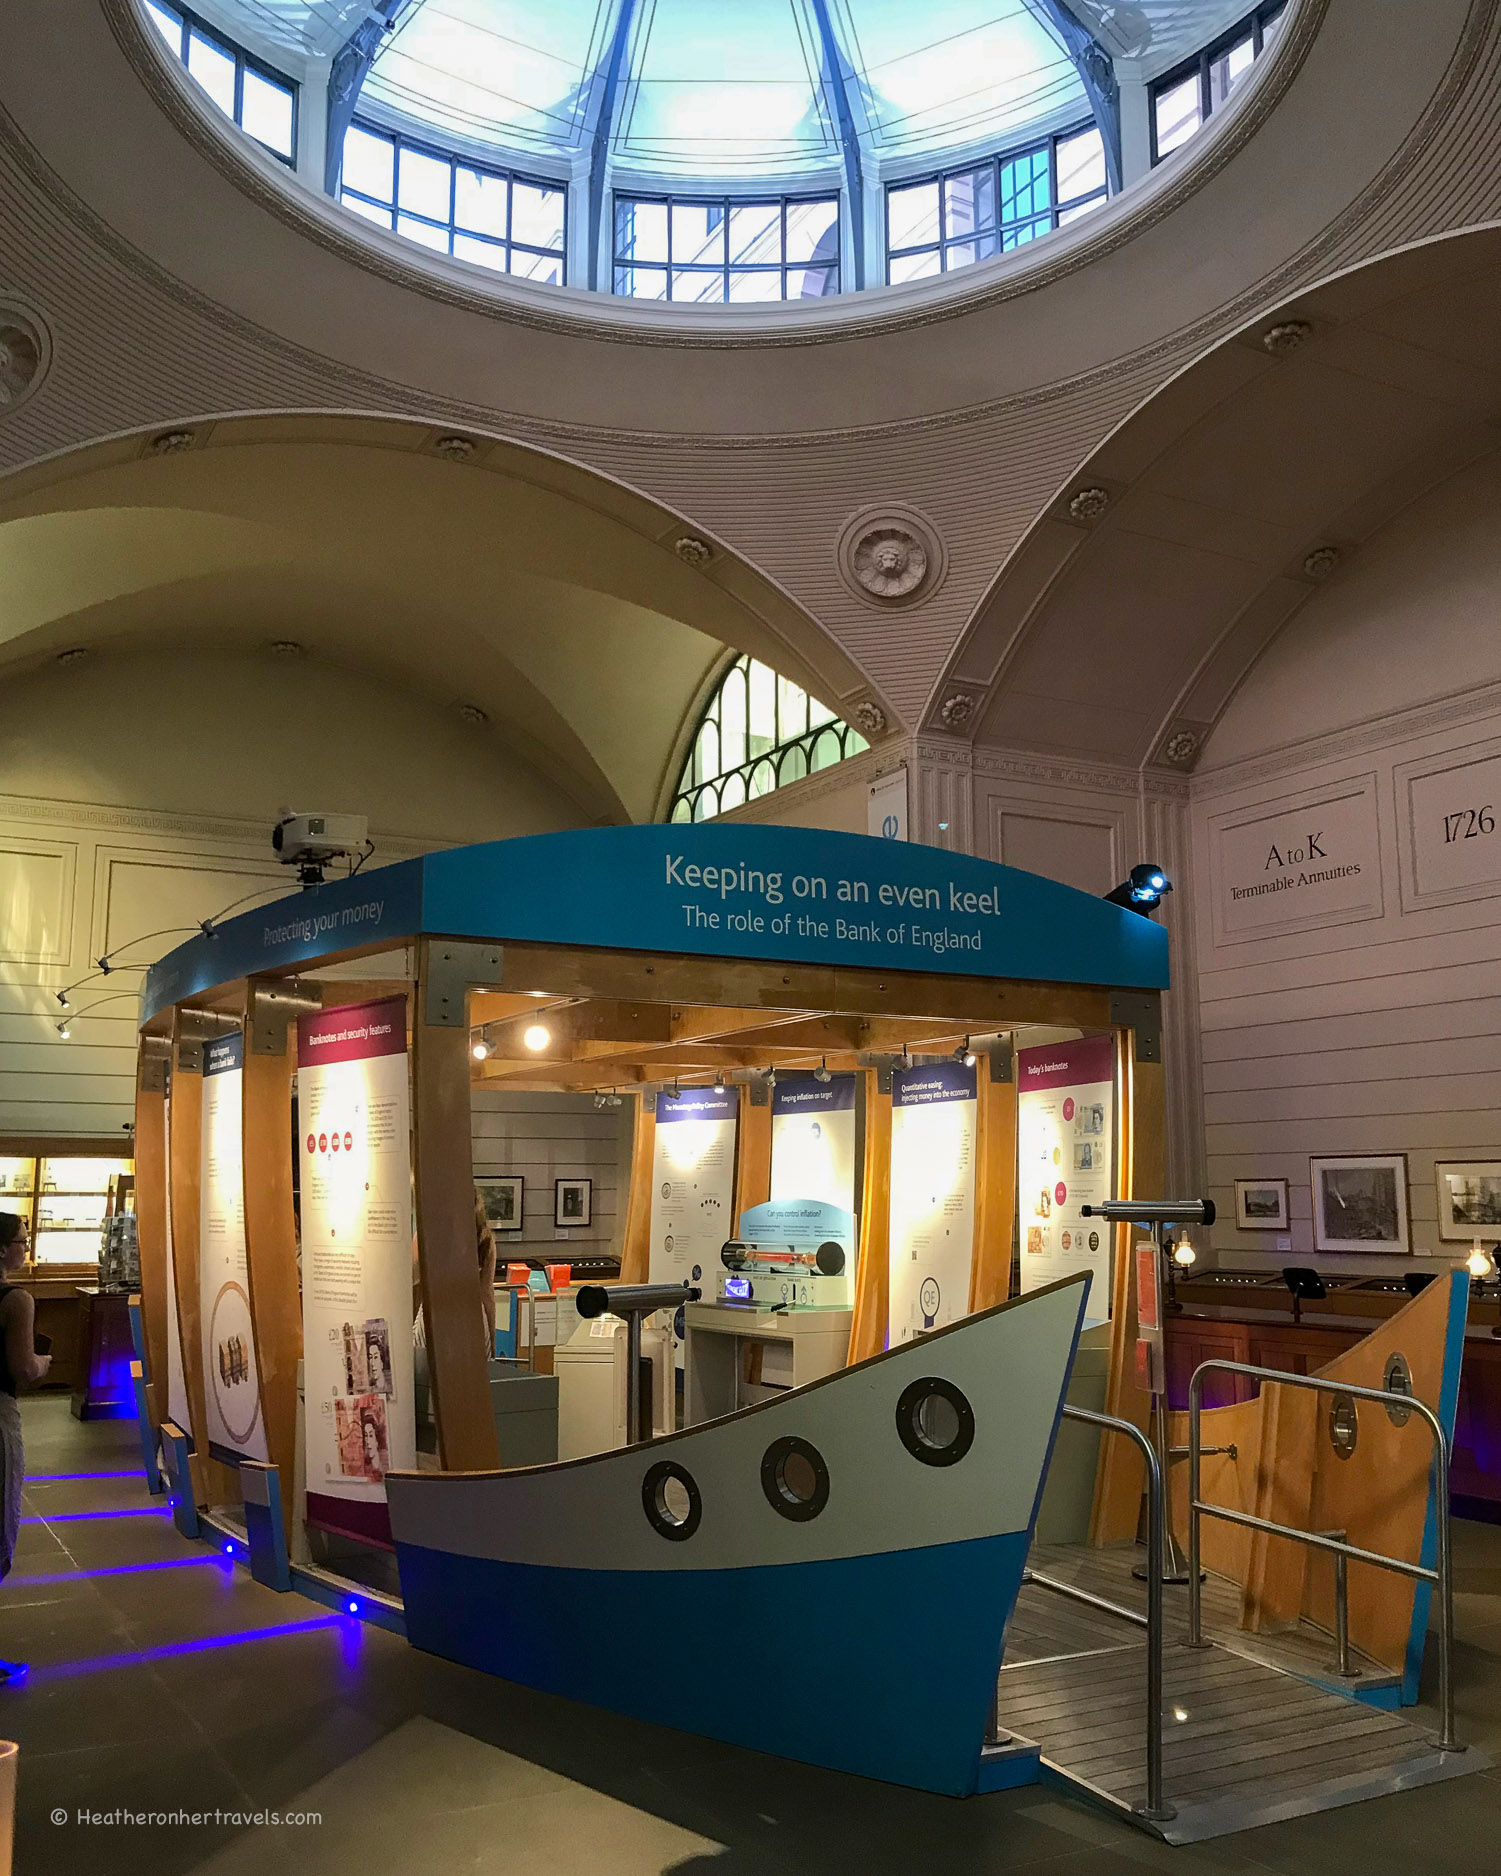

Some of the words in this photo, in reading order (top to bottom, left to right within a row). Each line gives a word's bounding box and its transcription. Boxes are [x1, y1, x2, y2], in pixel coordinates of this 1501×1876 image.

[1442, 805, 1495, 843] 1726
[1264, 844, 1285, 870] A
[1287, 849, 1304, 865] to
[1306, 831, 1328, 860] K
[665, 854, 783, 904] Keeping
[791, 875, 827, 899] on
[837, 879, 869, 903] an
[878, 884, 941, 910] even
[949, 882, 1001, 916] keel
[1230, 876, 1295, 900] Terminable
[1297, 863, 1361, 888] Annuities
[264, 918, 311, 947] Protecting
[312, 911, 340, 939] your
[341, 901, 384, 925] money
[682, 904, 720, 929] The
[727, 909, 764, 933] role
[771, 913, 791, 935] of
[797, 915, 829, 939] the
[836, 918, 881, 943] Bank
[887, 924, 906, 945] of
[912, 925, 982, 953] England
[309, 1033, 337, 1046] Banknotes
[337, 1029, 347, 1041] and
[347, 1026, 368, 1040] security
[369, 1024, 391, 1036] features
[1027, 1063, 1044, 1076] Today's
[1044, 1061, 1069, 1073] banknotes
[781, 1095, 796, 1103] Keeping
[797, 1092, 814, 1101] inflation
[820, 1091, 833, 1101] target
[901, 1082, 928, 1093] Quantitative
[919, 1093, 933, 1101] money
[942, 1089, 950, 1098] the
[950, 1088, 970, 1097] economy
[767, 1209, 775, 1218] Can
[776, 1211, 784, 1219] you
[785, 1209, 800, 1218] control
[923, 1290, 936, 1307] QE
